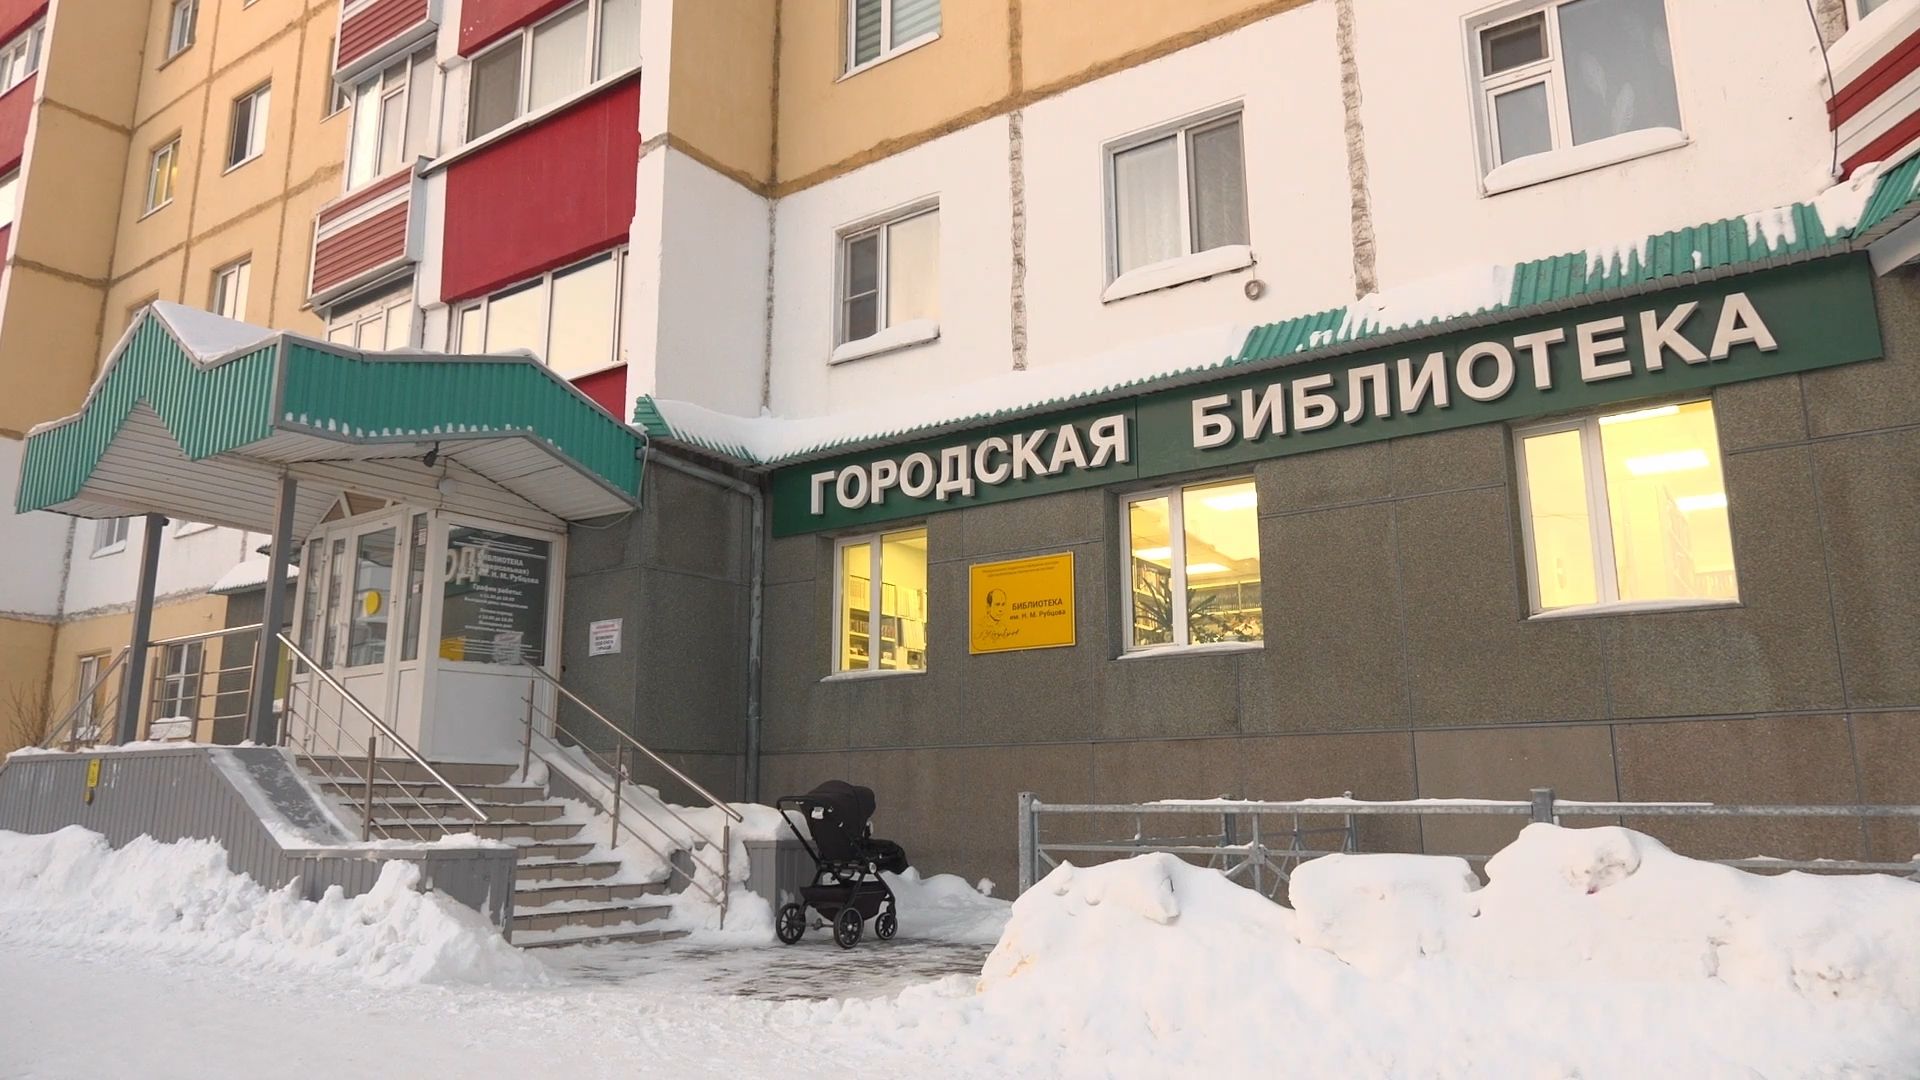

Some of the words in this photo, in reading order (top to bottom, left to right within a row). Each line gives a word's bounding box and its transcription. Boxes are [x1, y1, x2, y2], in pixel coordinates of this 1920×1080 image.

[811, 414, 1130, 516] ГОРОДСКАЯ
[1192, 292, 1778, 449] БИБЛИОТЕКА
[1012, 598, 1063, 612] БИБЛИОТЕКА
[1038, 608, 1066, 619] Рубцова
